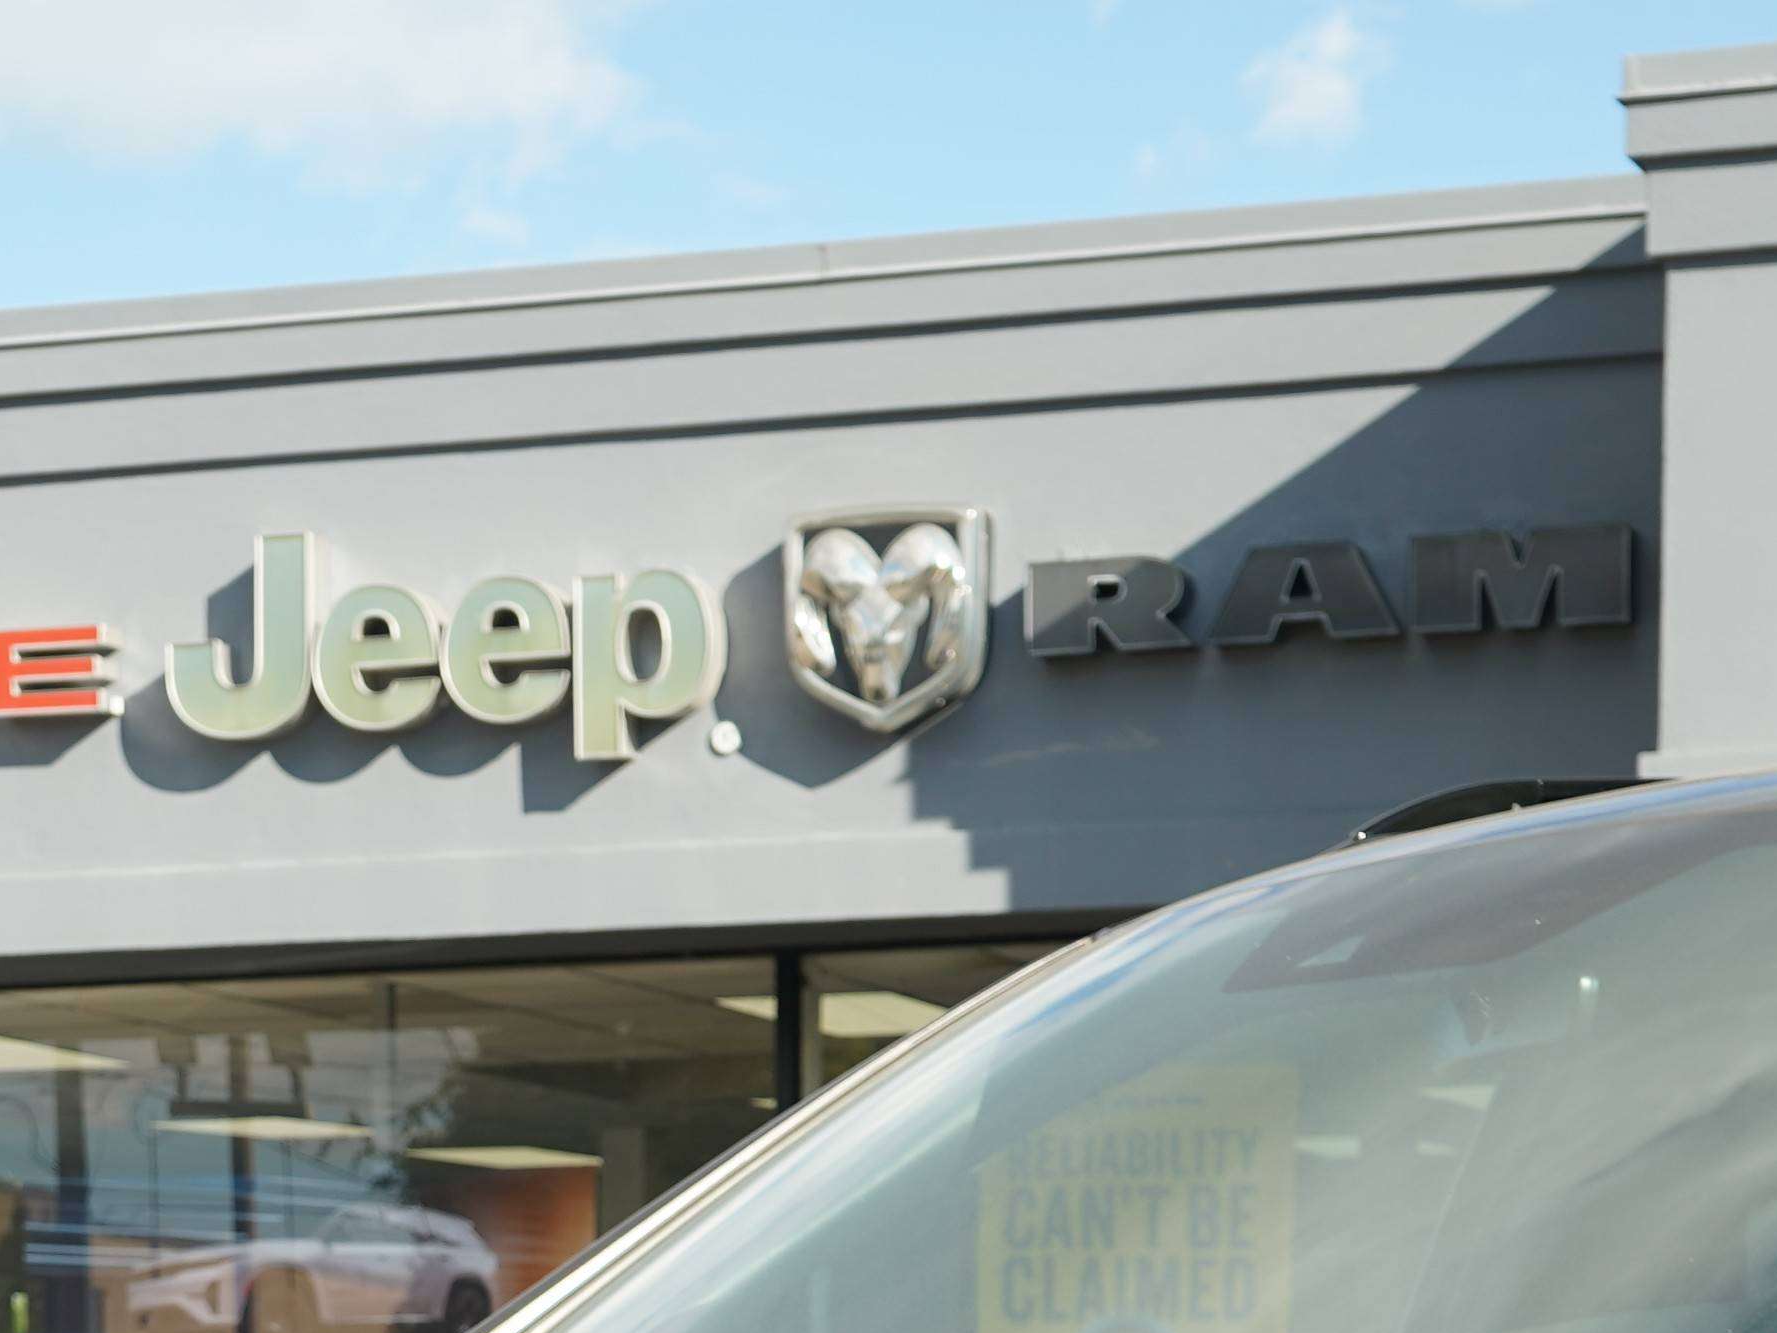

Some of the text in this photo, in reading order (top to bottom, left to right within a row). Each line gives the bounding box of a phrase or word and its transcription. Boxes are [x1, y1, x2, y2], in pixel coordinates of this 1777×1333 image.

[1027, 522, 1633, 660] RAM
[164, 530, 726, 761] Jeep
[1002, 1183, 1259, 1250] CAN'T BE
[1000, 1254, 1258, 1324] CLAIMED
